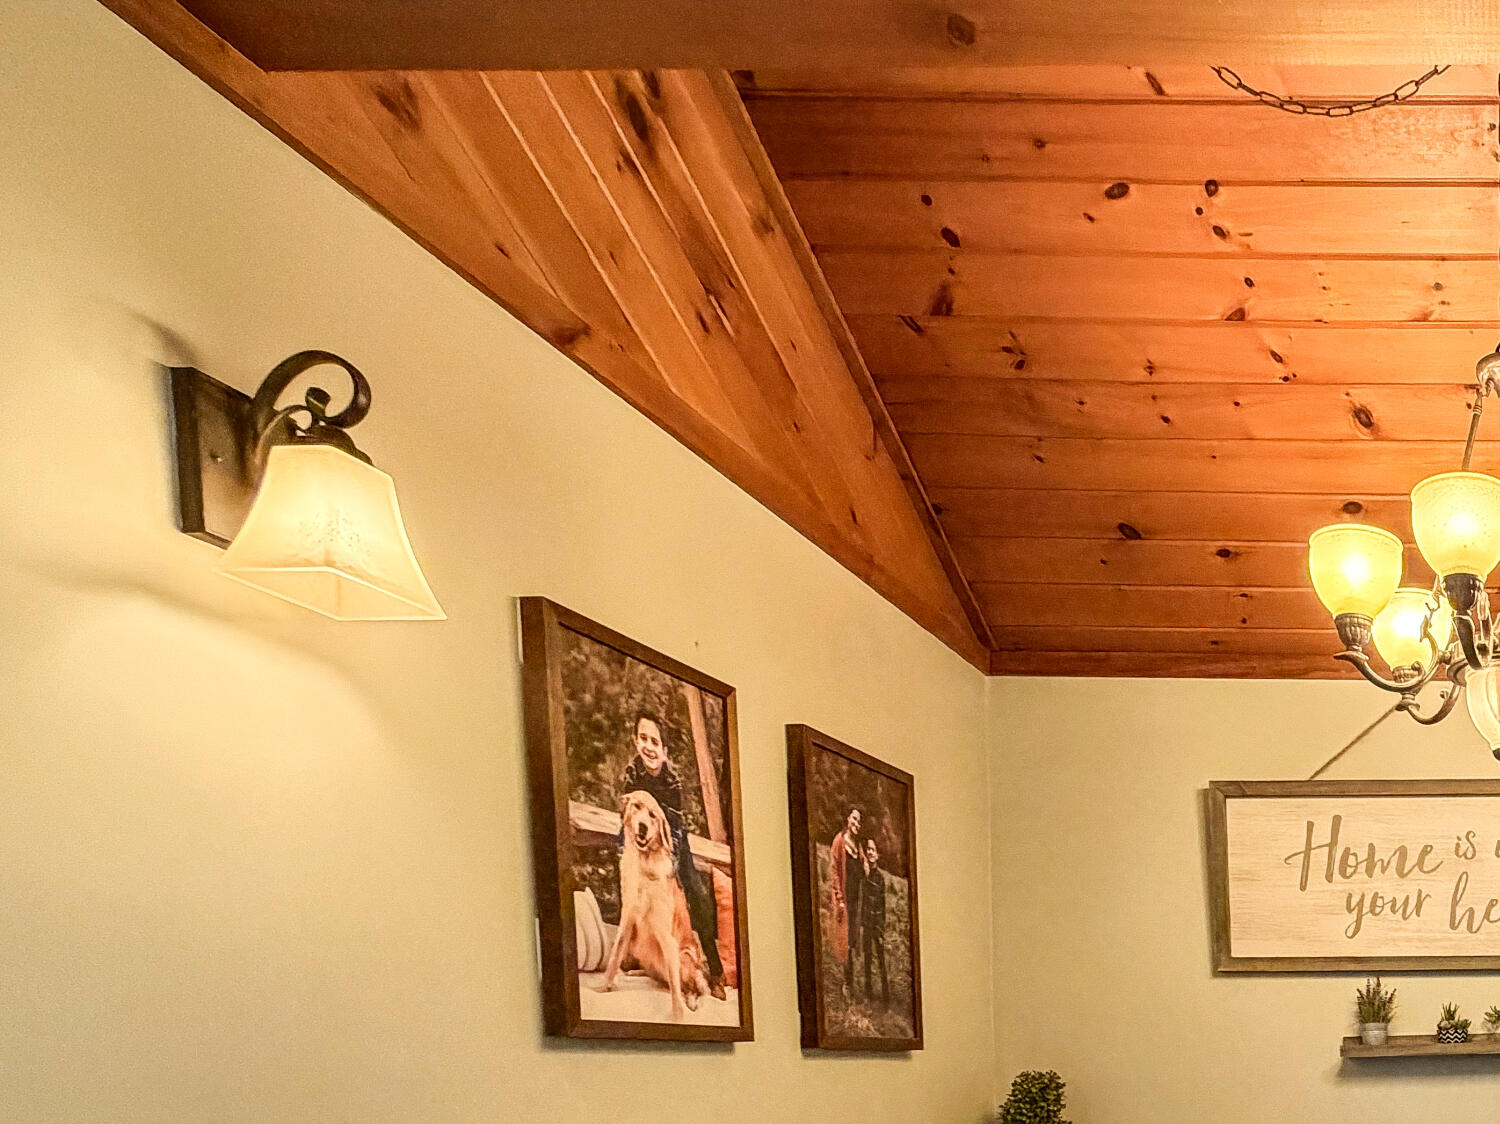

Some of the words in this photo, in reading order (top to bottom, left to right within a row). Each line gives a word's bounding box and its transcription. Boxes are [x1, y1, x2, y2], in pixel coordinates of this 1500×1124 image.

[1285, 814, 1443, 892] Home
[1455, 830, 1477, 861] is
[1345, 888, 1432, 939] your
